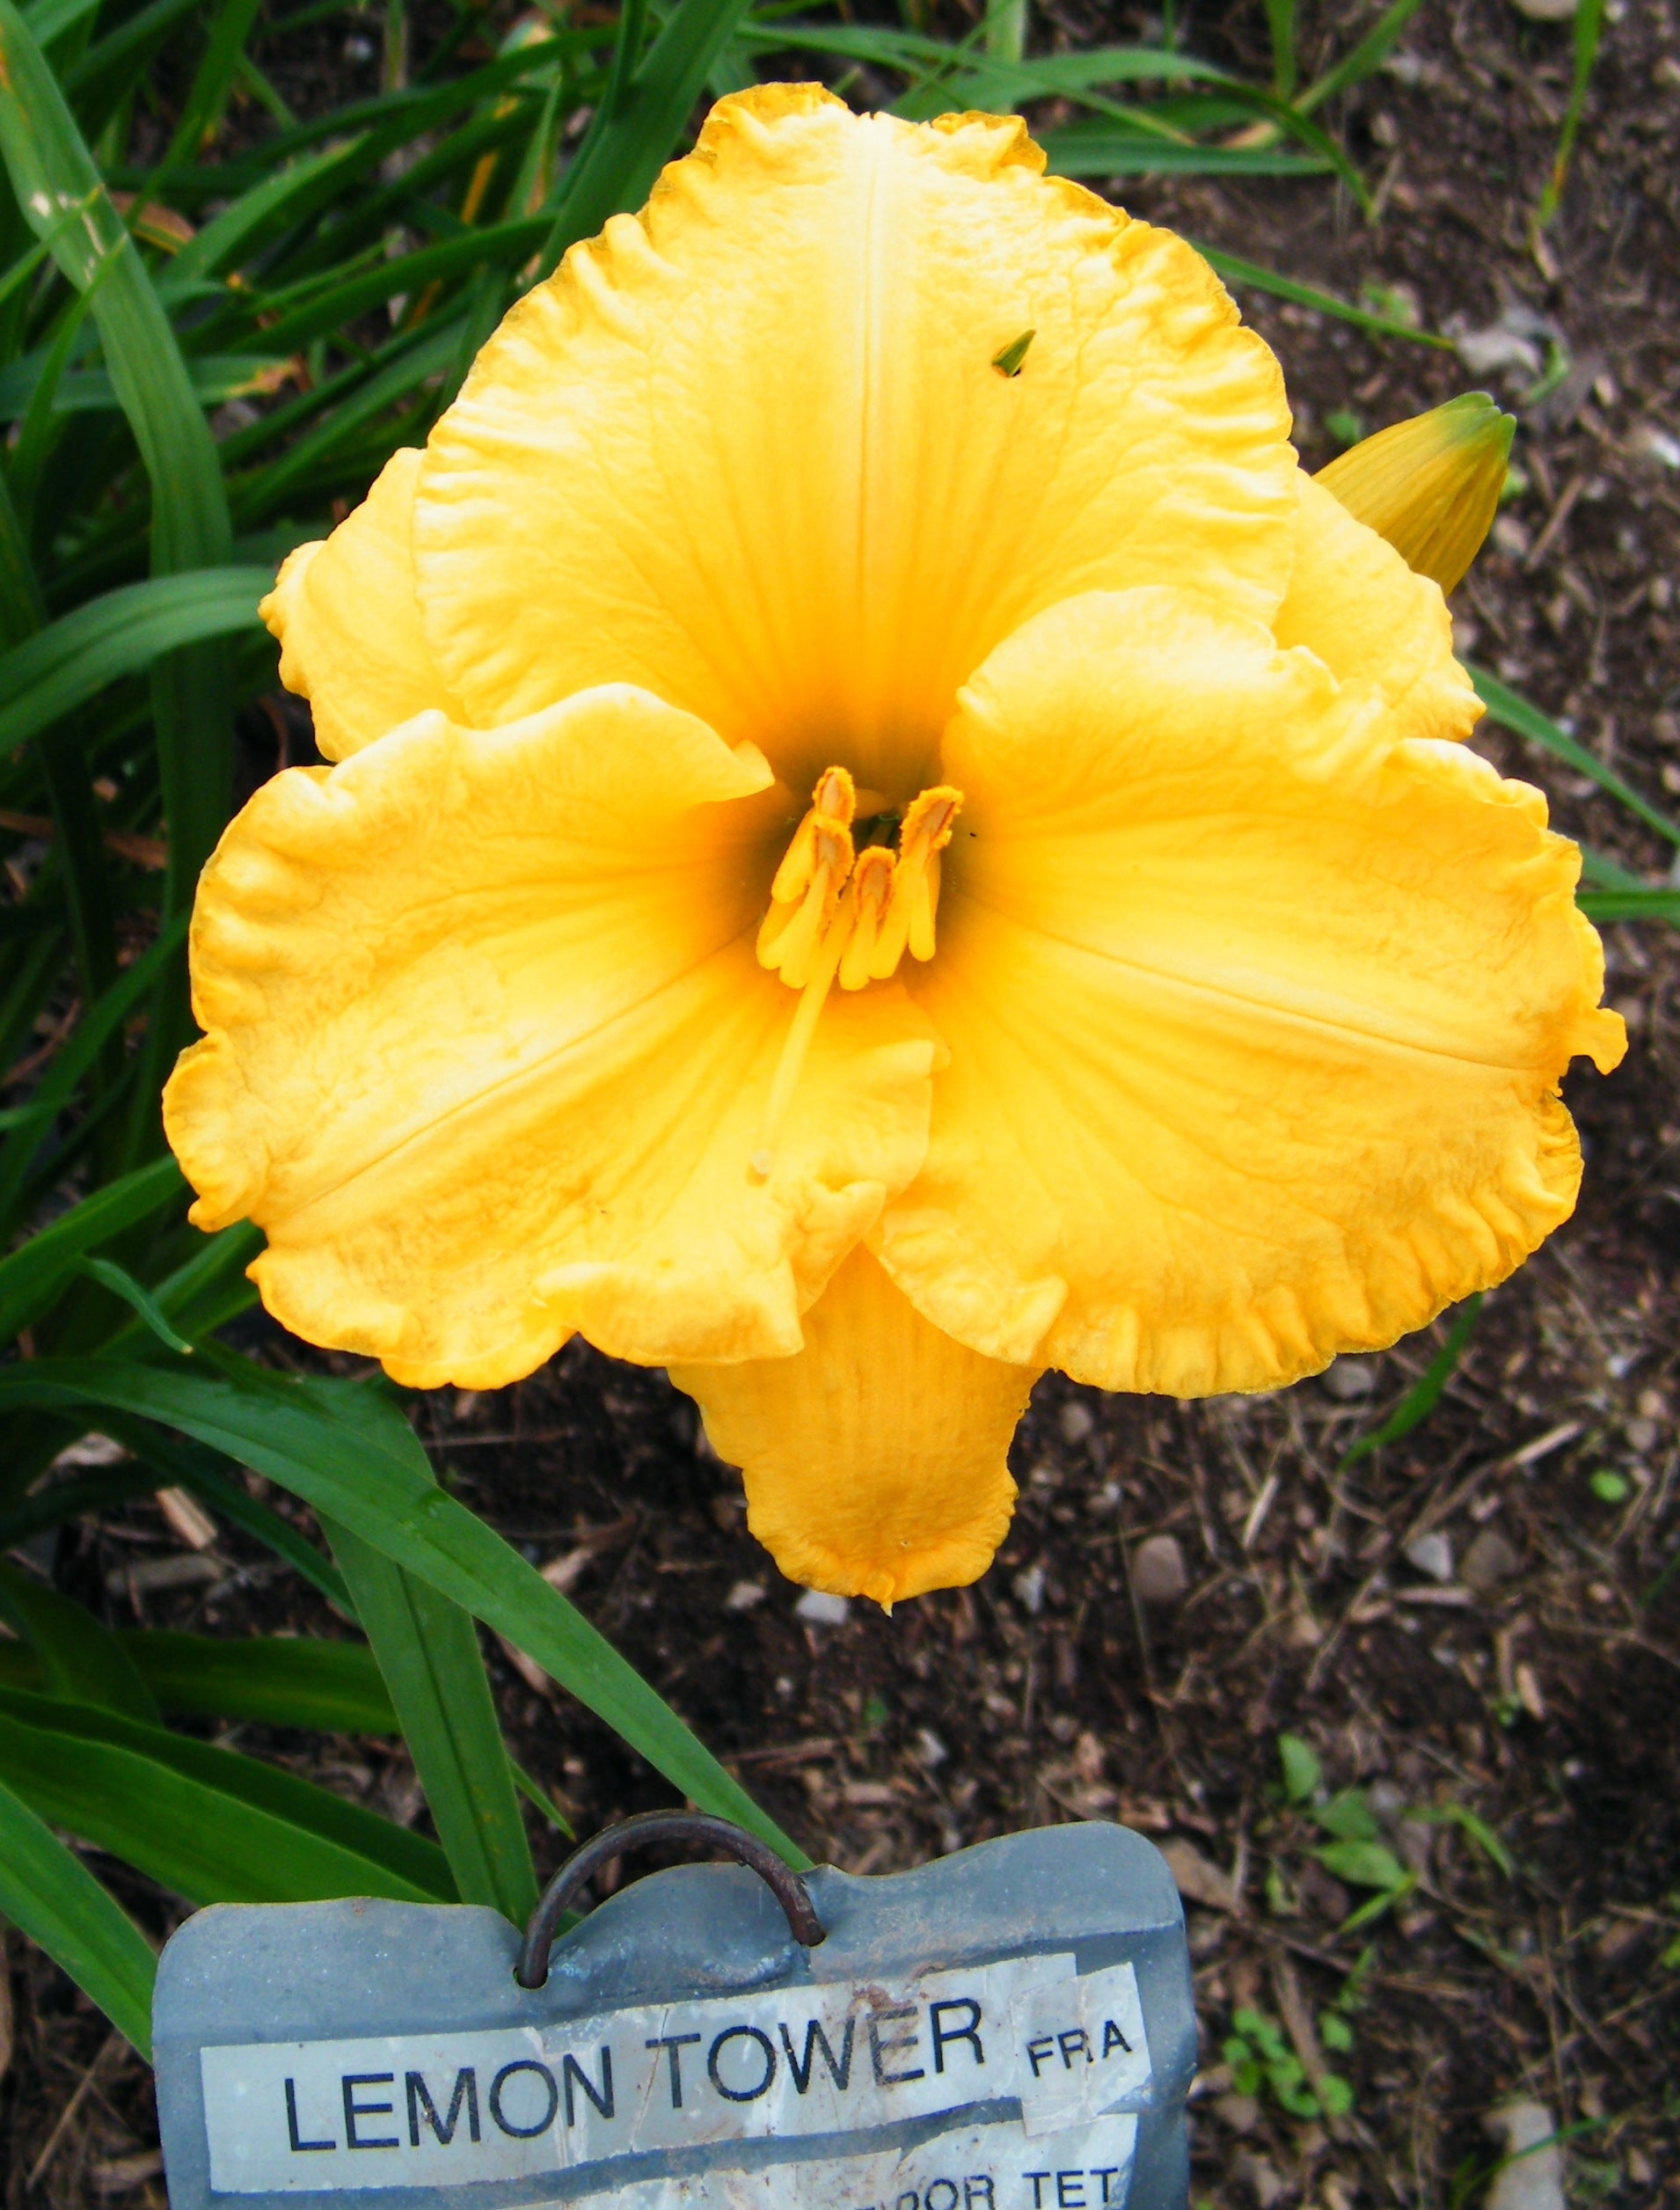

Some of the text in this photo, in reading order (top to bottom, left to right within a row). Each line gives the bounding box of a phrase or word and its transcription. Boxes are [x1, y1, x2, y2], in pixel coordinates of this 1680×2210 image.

[283, 1996, 1133, 2151] LEMON TOWER FRA
[1022, 2167, 1119, 2210] TET
